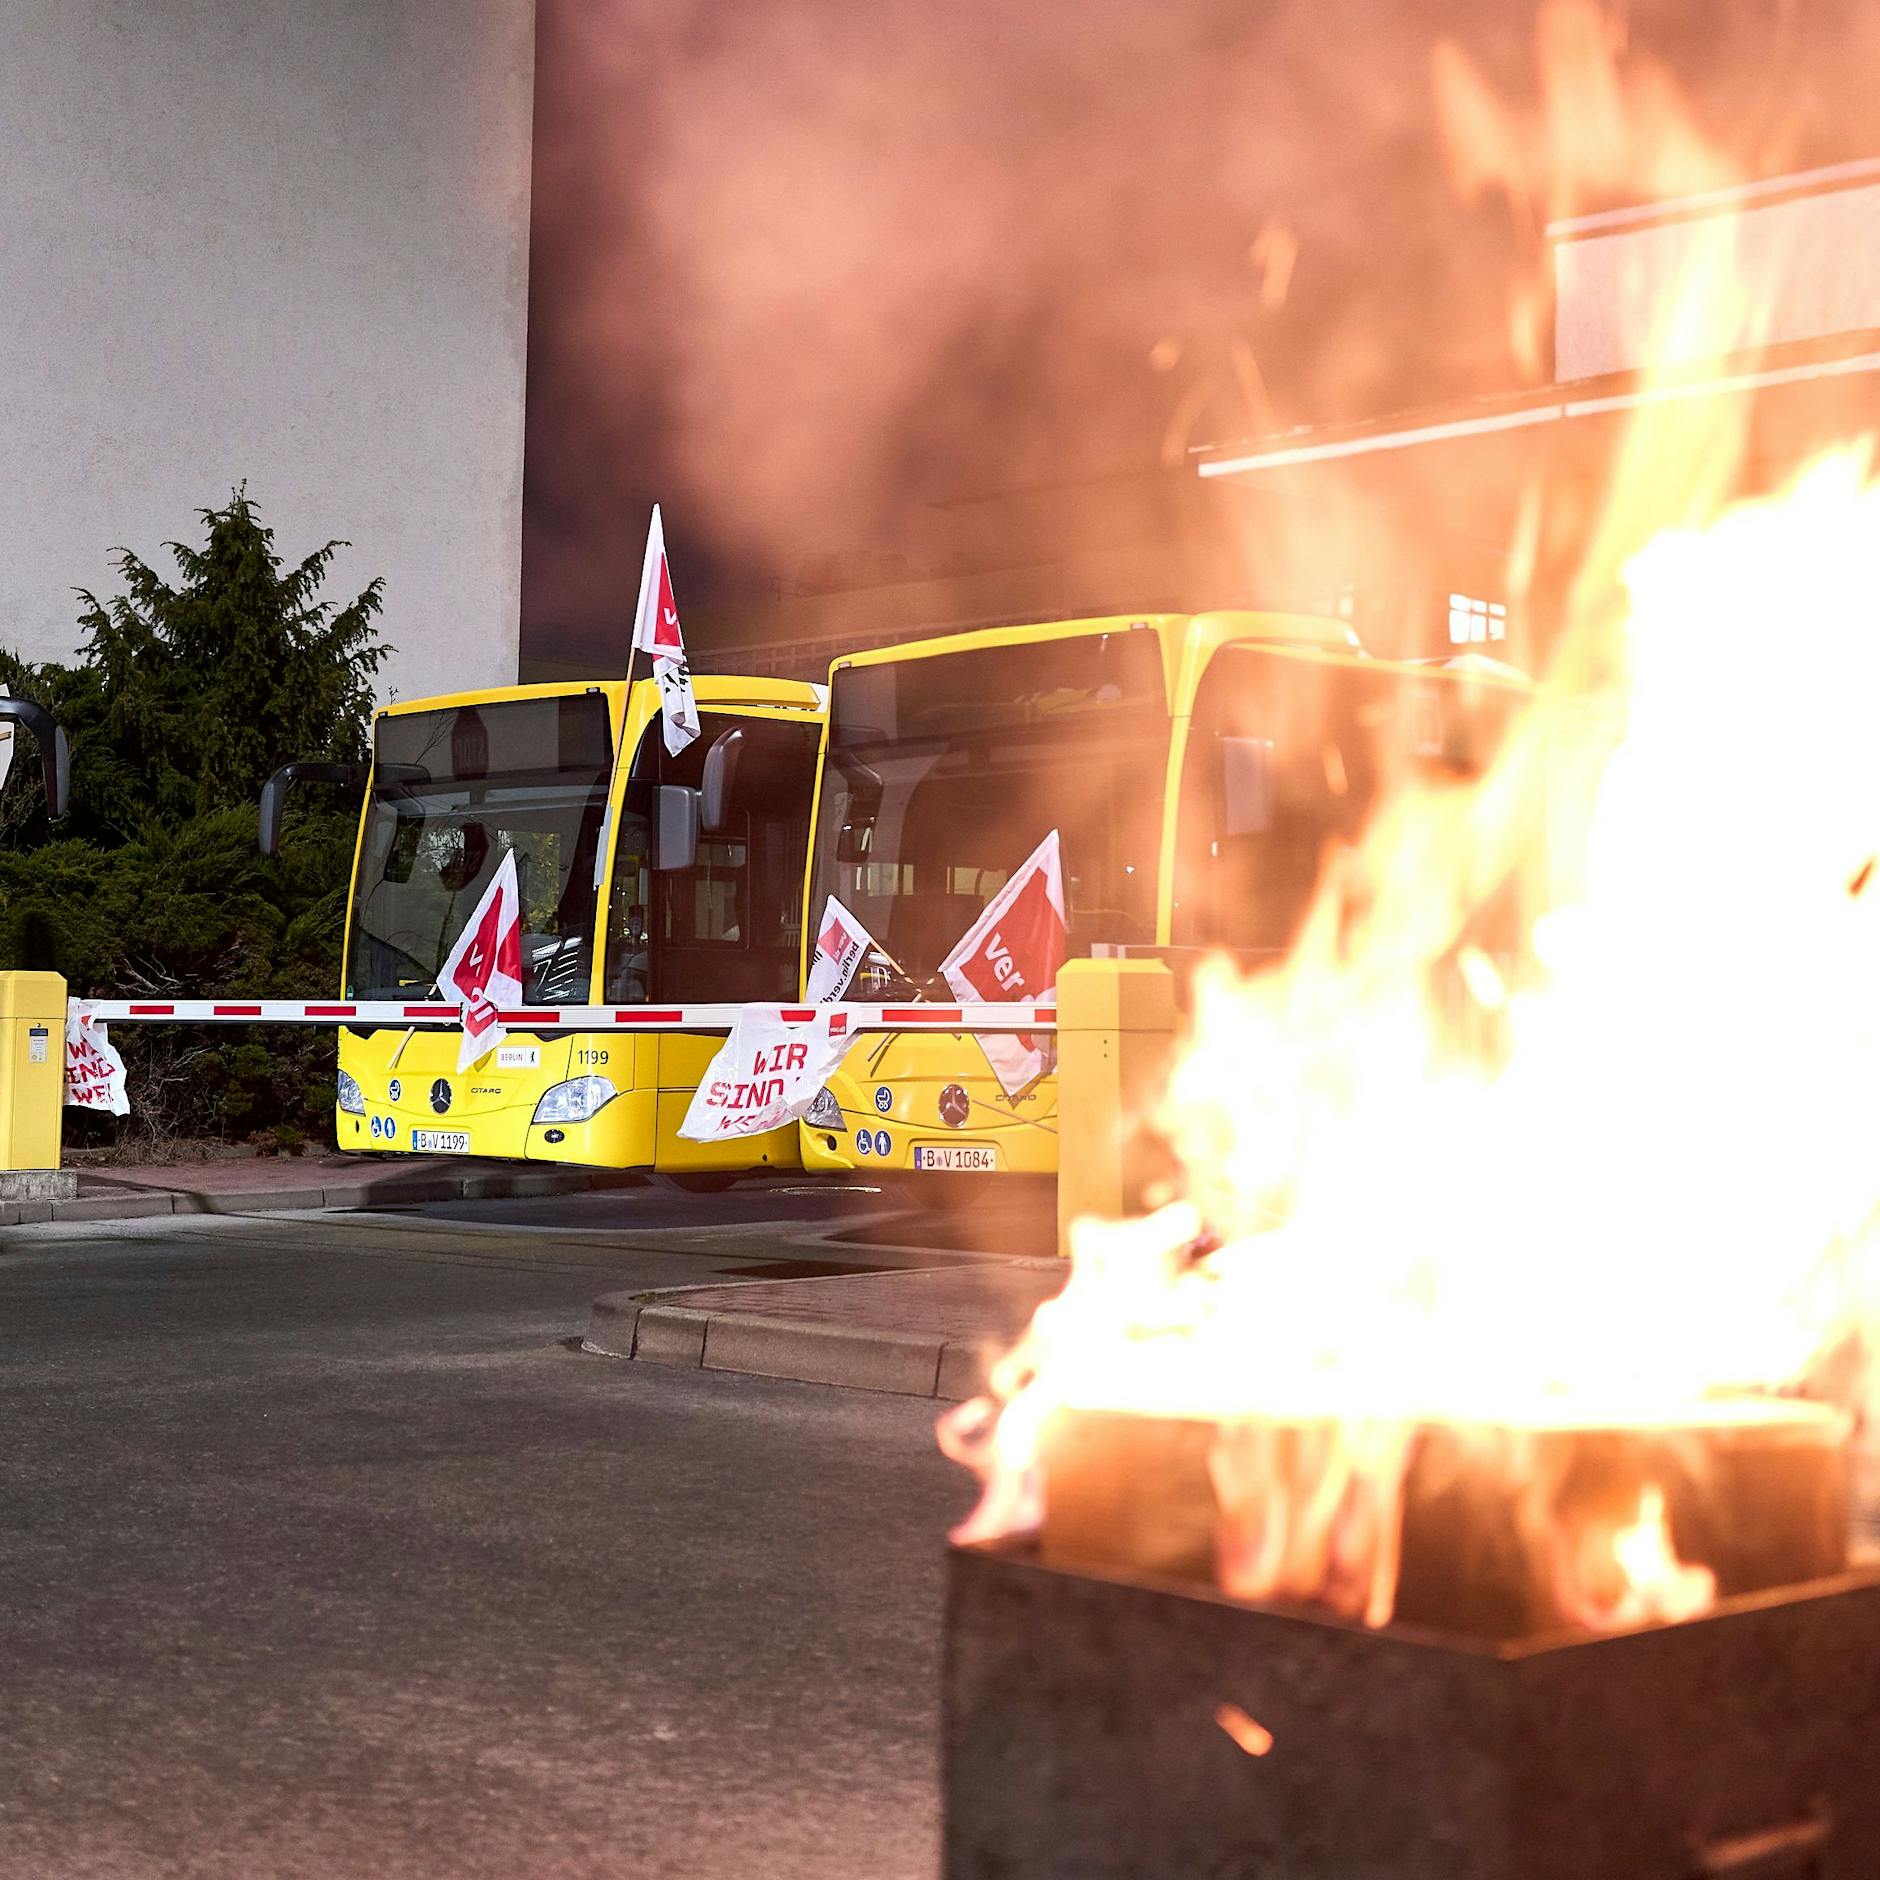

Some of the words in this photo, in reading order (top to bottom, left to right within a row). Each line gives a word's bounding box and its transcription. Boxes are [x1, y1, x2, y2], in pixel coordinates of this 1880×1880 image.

[985, 932, 1028, 996] ver
[64, 1057, 116, 1084] IND
[500, 1053, 523, 1061] BERLIN
[578, 1050, 609, 1065] 1199
[753, 1043, 808, 1076] WIR
[706, 1078, 784, 1109] SIND
